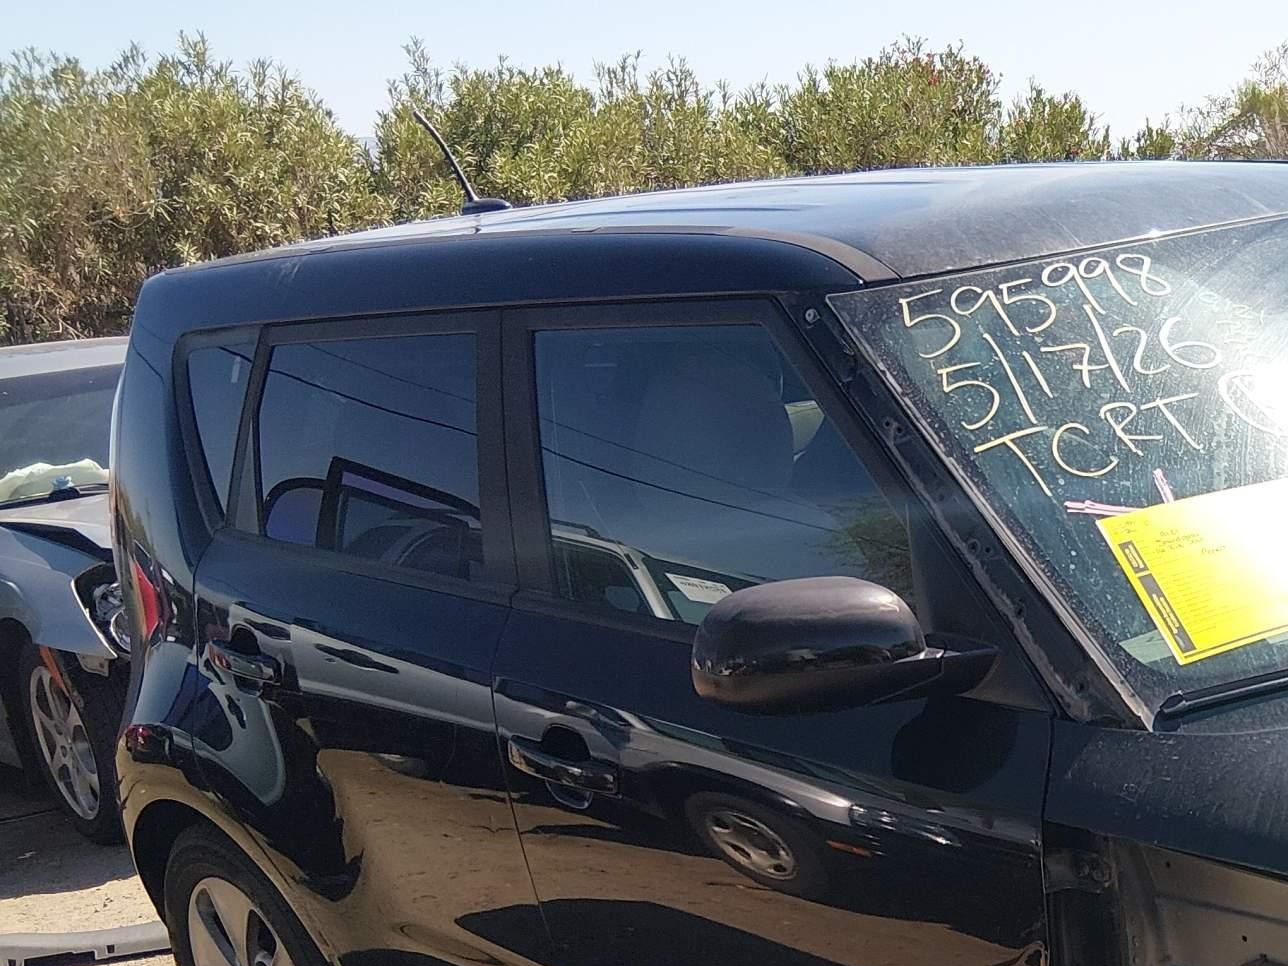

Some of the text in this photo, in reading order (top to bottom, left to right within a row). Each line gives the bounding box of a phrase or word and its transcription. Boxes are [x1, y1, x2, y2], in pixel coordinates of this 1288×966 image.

[899, 253, 1172, 359] 595998
[937, 303, 1222, 431] 5/17/26
[974, 392, 1205, 497] TCRT
